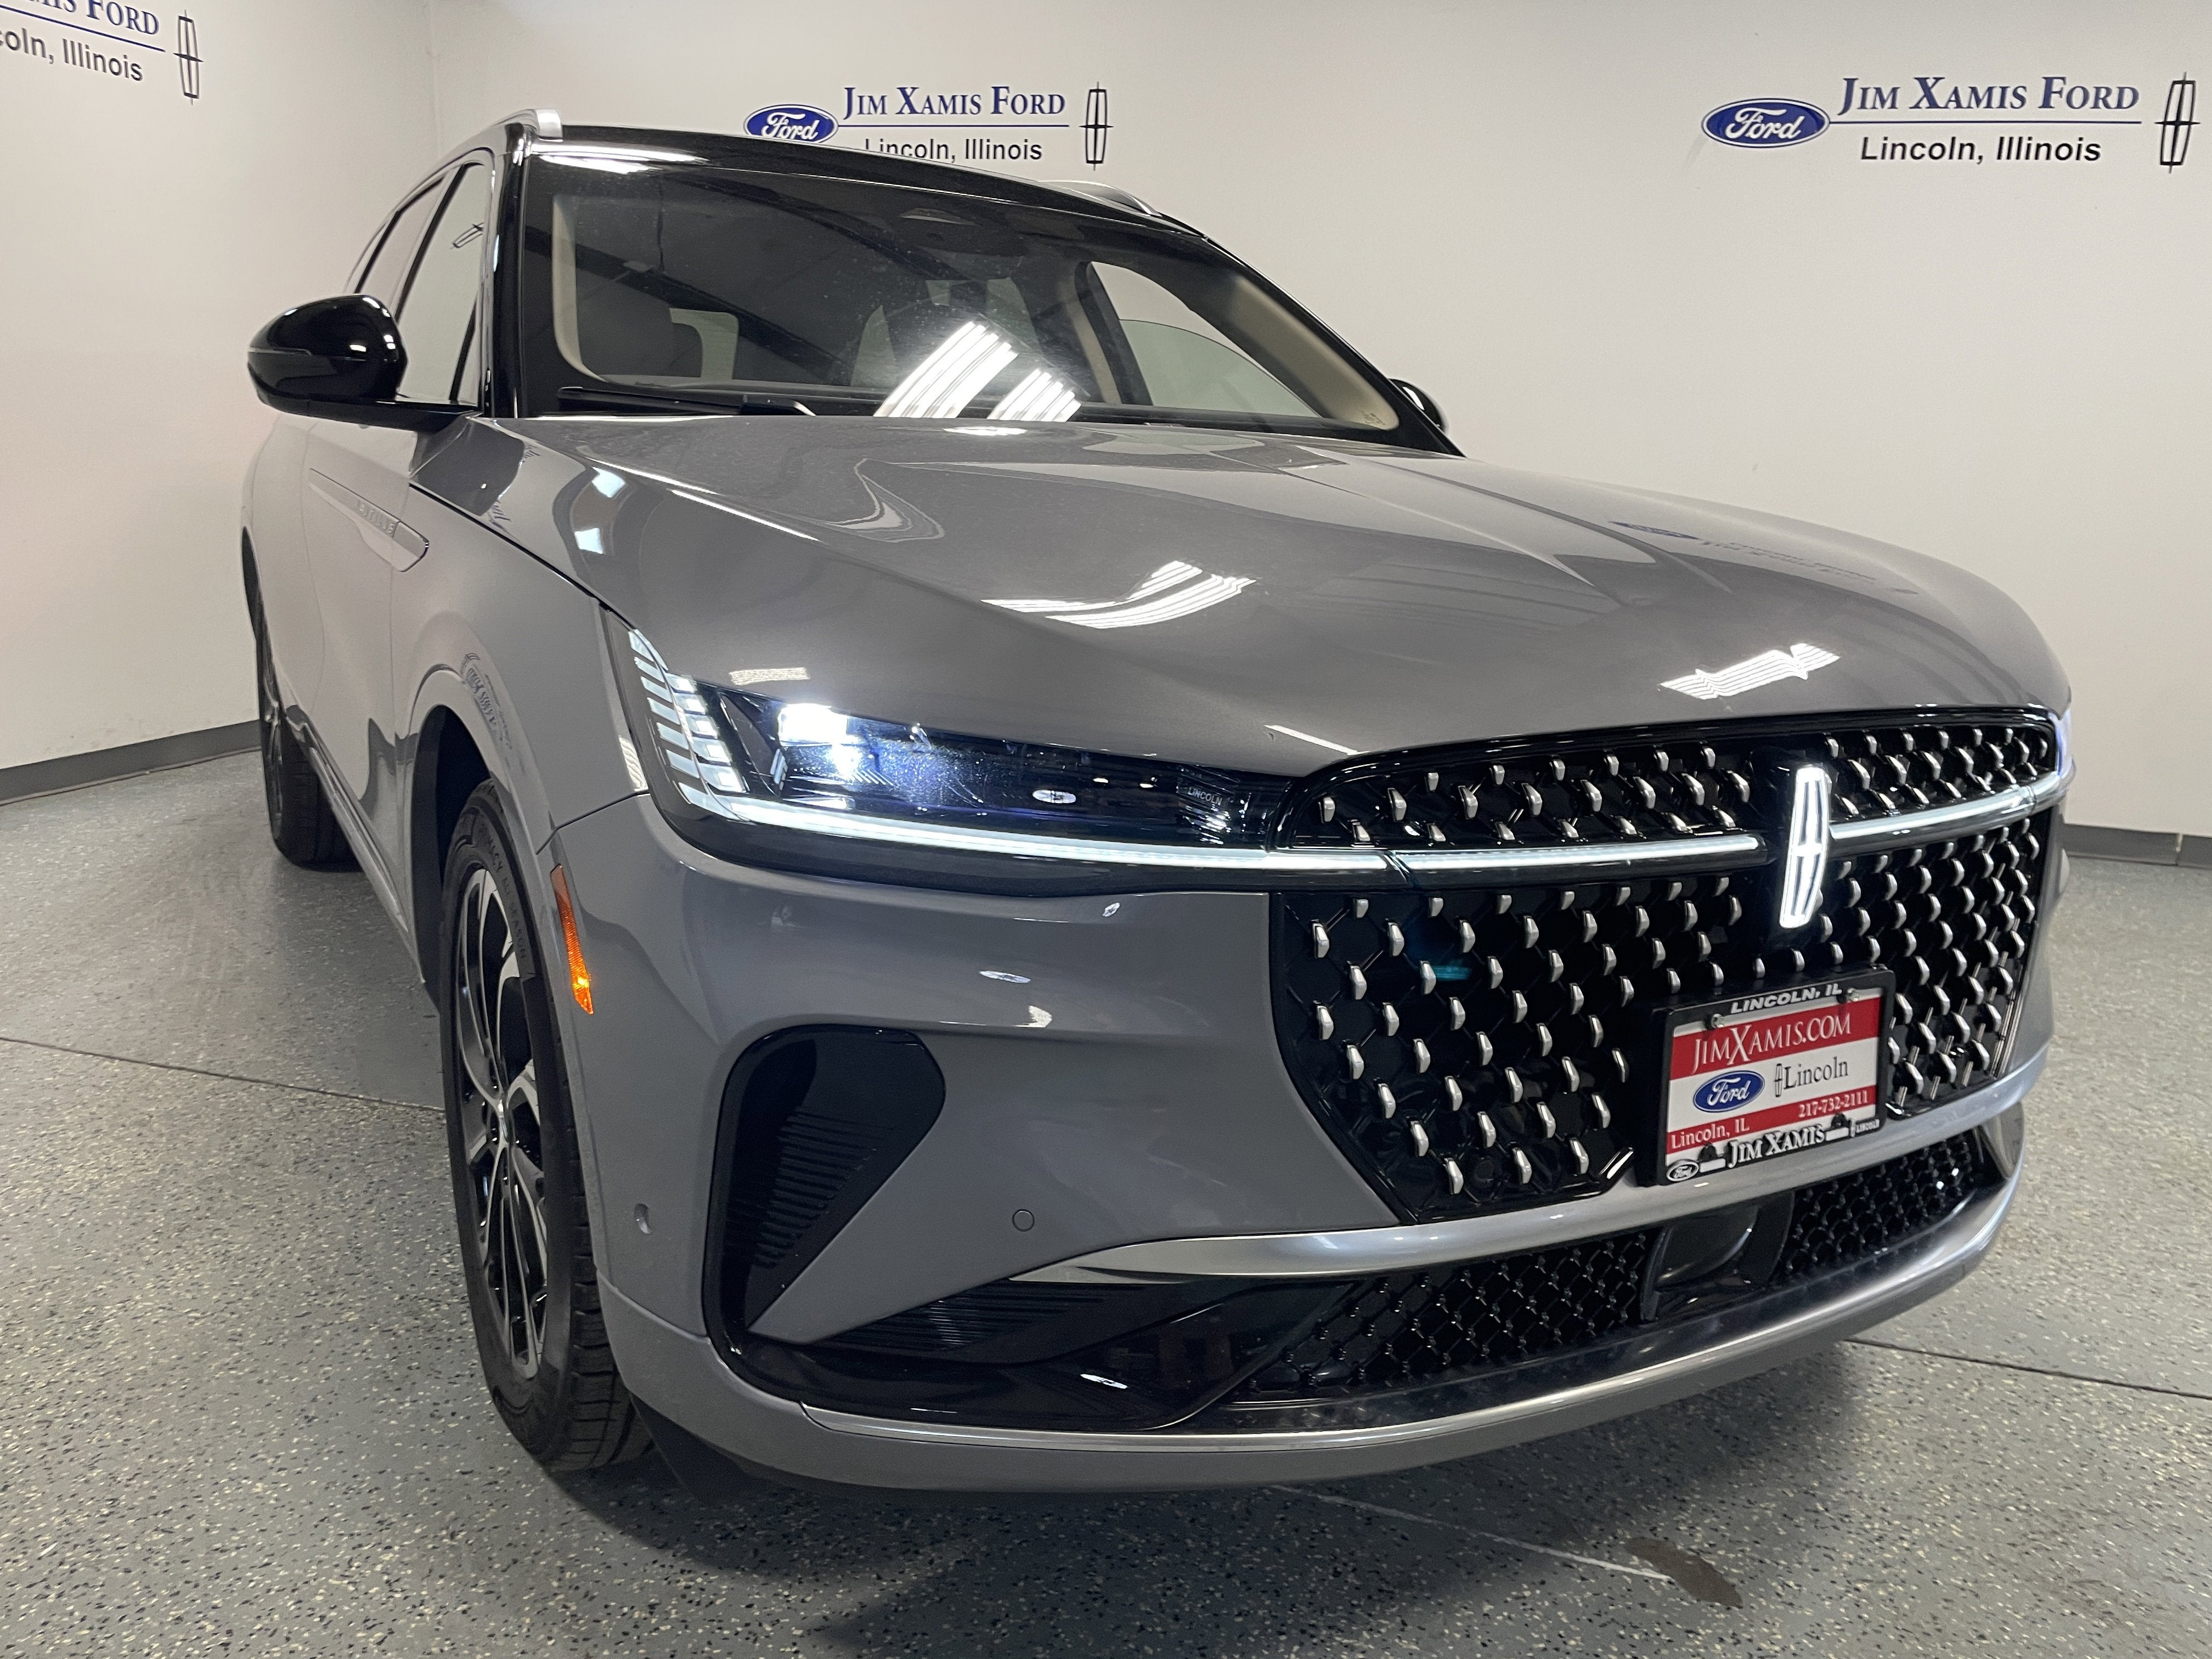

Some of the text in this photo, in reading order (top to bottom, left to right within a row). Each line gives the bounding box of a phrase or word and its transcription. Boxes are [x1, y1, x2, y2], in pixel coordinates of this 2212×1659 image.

[0, 27, 143, 81] oln, Illinois
[843, 86, 1065, 120] JIM XAMIS FORD
[1837, 76, 2140, 116] JIM XAMIS FORD
[761, 112, 820, 140] Ford
[1725, 108, 1805, 139] Ford
[965, 138, 1042, 160] Illinois
[1861, 136, 2102, 165] Lincoln, Illinois
[1188, 787, 1223, 806] LINCOLN
[1730, 983, 1843, 1014] LINCOLN, IL
[1692, 1013, 1852, 1075] JIMXAMIS.COM
[1783, 1056, 1849, 1090] Lincoln
[1707, 1077, 1751, 1107] Ford
[1798, 1090, 1869, 1118] 217-732-2111
[1671, 1118, 1750, 1149] Lincoln, IL
[1728, 1124, 1826, 1170] JIM XAMIS
